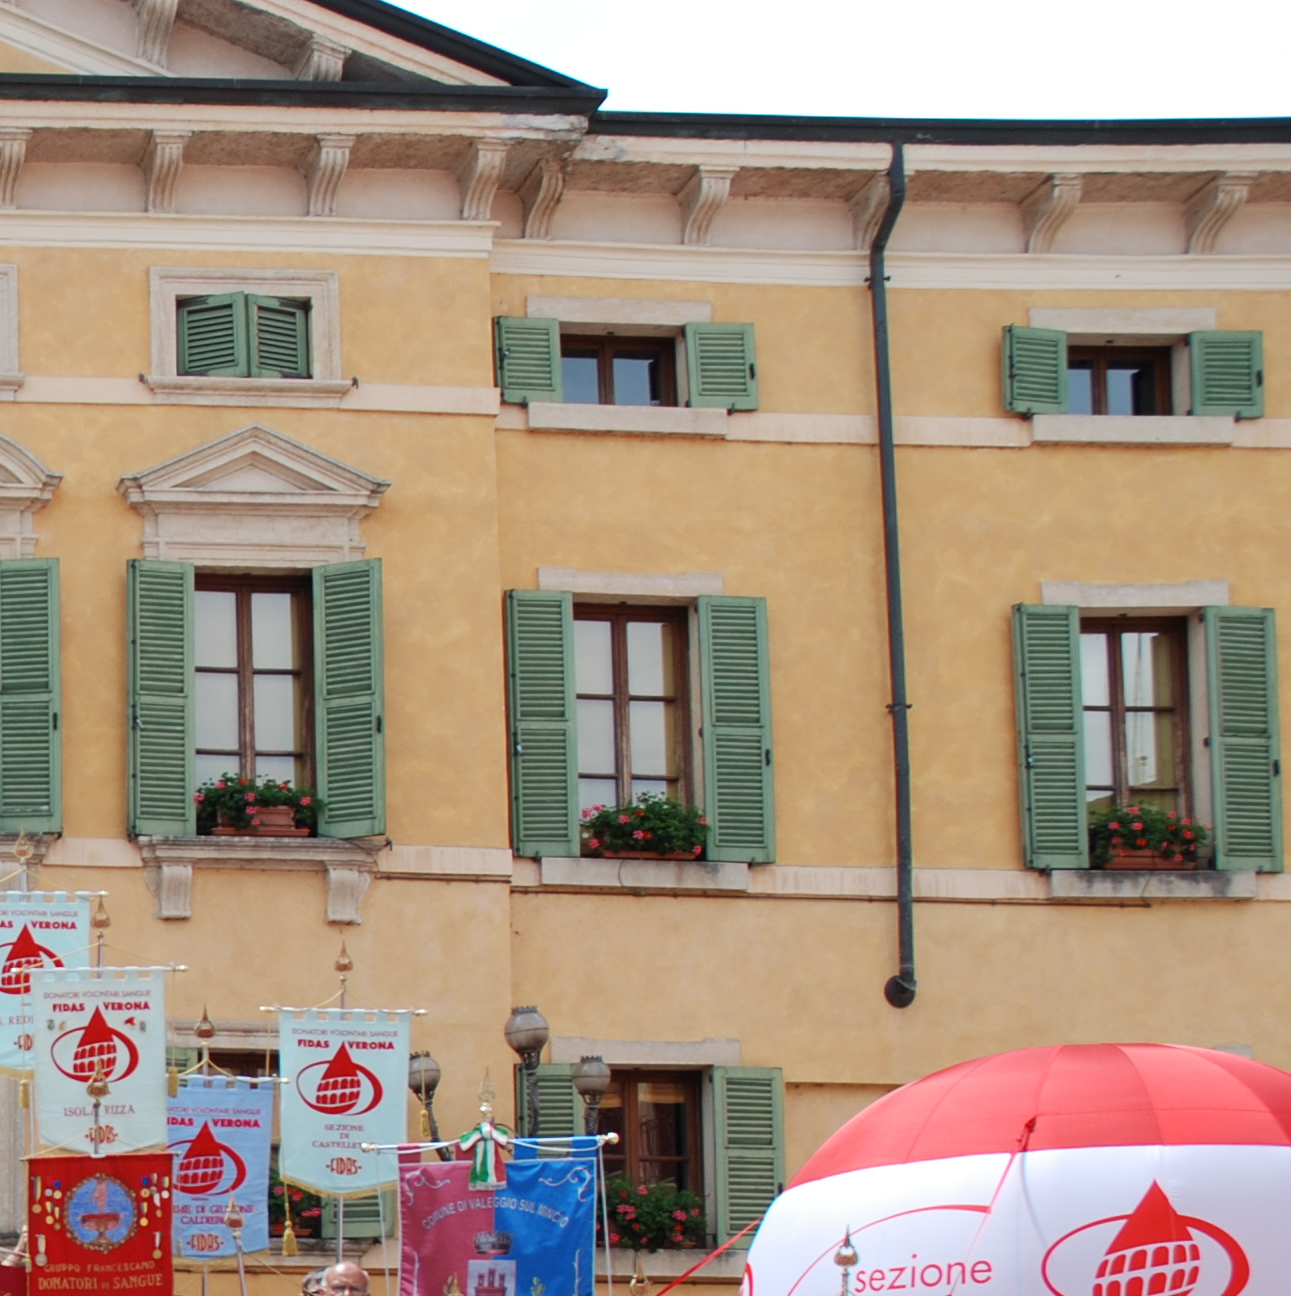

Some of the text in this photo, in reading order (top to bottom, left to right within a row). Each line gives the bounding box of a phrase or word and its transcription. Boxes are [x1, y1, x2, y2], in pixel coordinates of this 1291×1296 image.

[298, 1039, 395, 1050] FIDAS VERONA
[457, 1200, 468, 1212] DI
[470, 1197, 517, 1209] VALEGGIO
[519, 1200, 535, 1213] SUL
[44, 1263, 80, 1273] GRUPPO
[855, 1253, 993, 1293] sezione
[38, 1273, 163, 1291] DONATORI SANGUE
